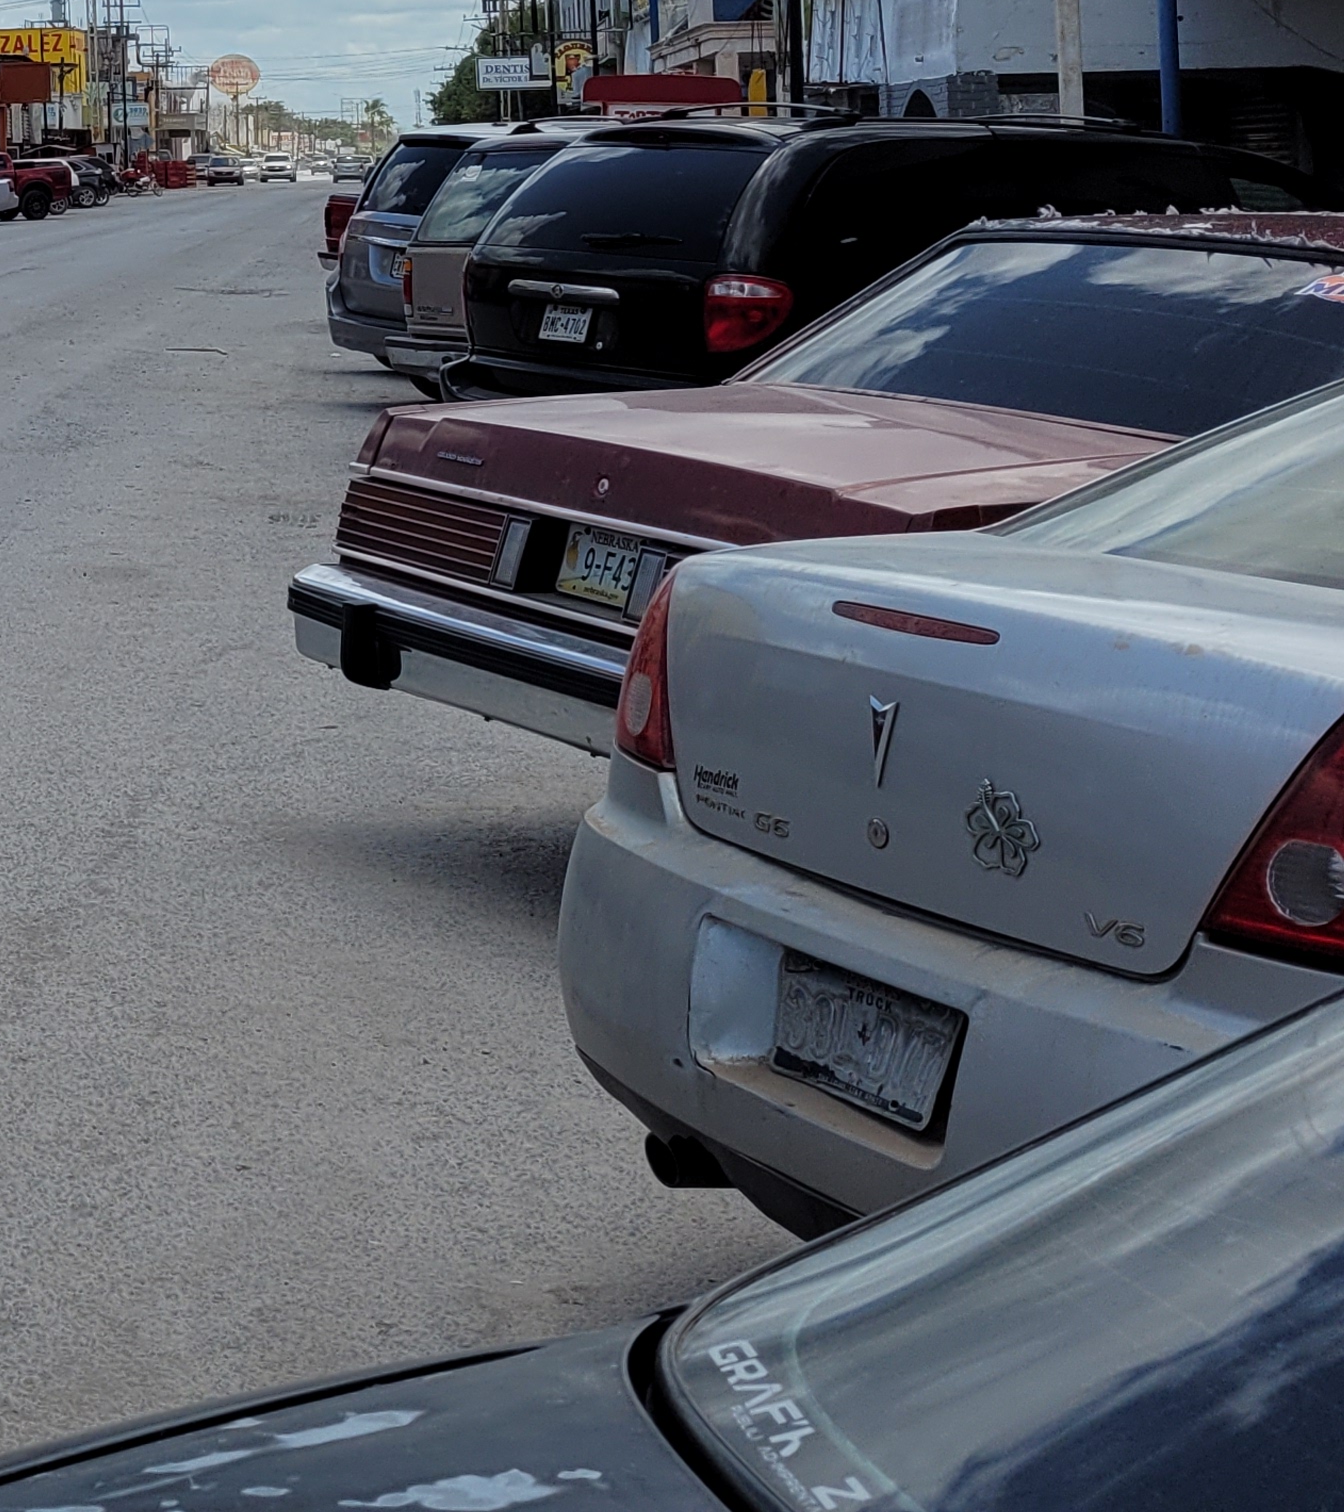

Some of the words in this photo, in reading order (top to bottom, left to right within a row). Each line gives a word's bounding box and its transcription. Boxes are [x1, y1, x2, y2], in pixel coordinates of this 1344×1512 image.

[592, 530, 639, 553] NEBRASKA
[694, 764, 739, 790] Hendrick
[755, 811, 790, 838] G6
[1084, 912, 1145, 948] V6
[847, 986, 894, 1014] TRUCK
